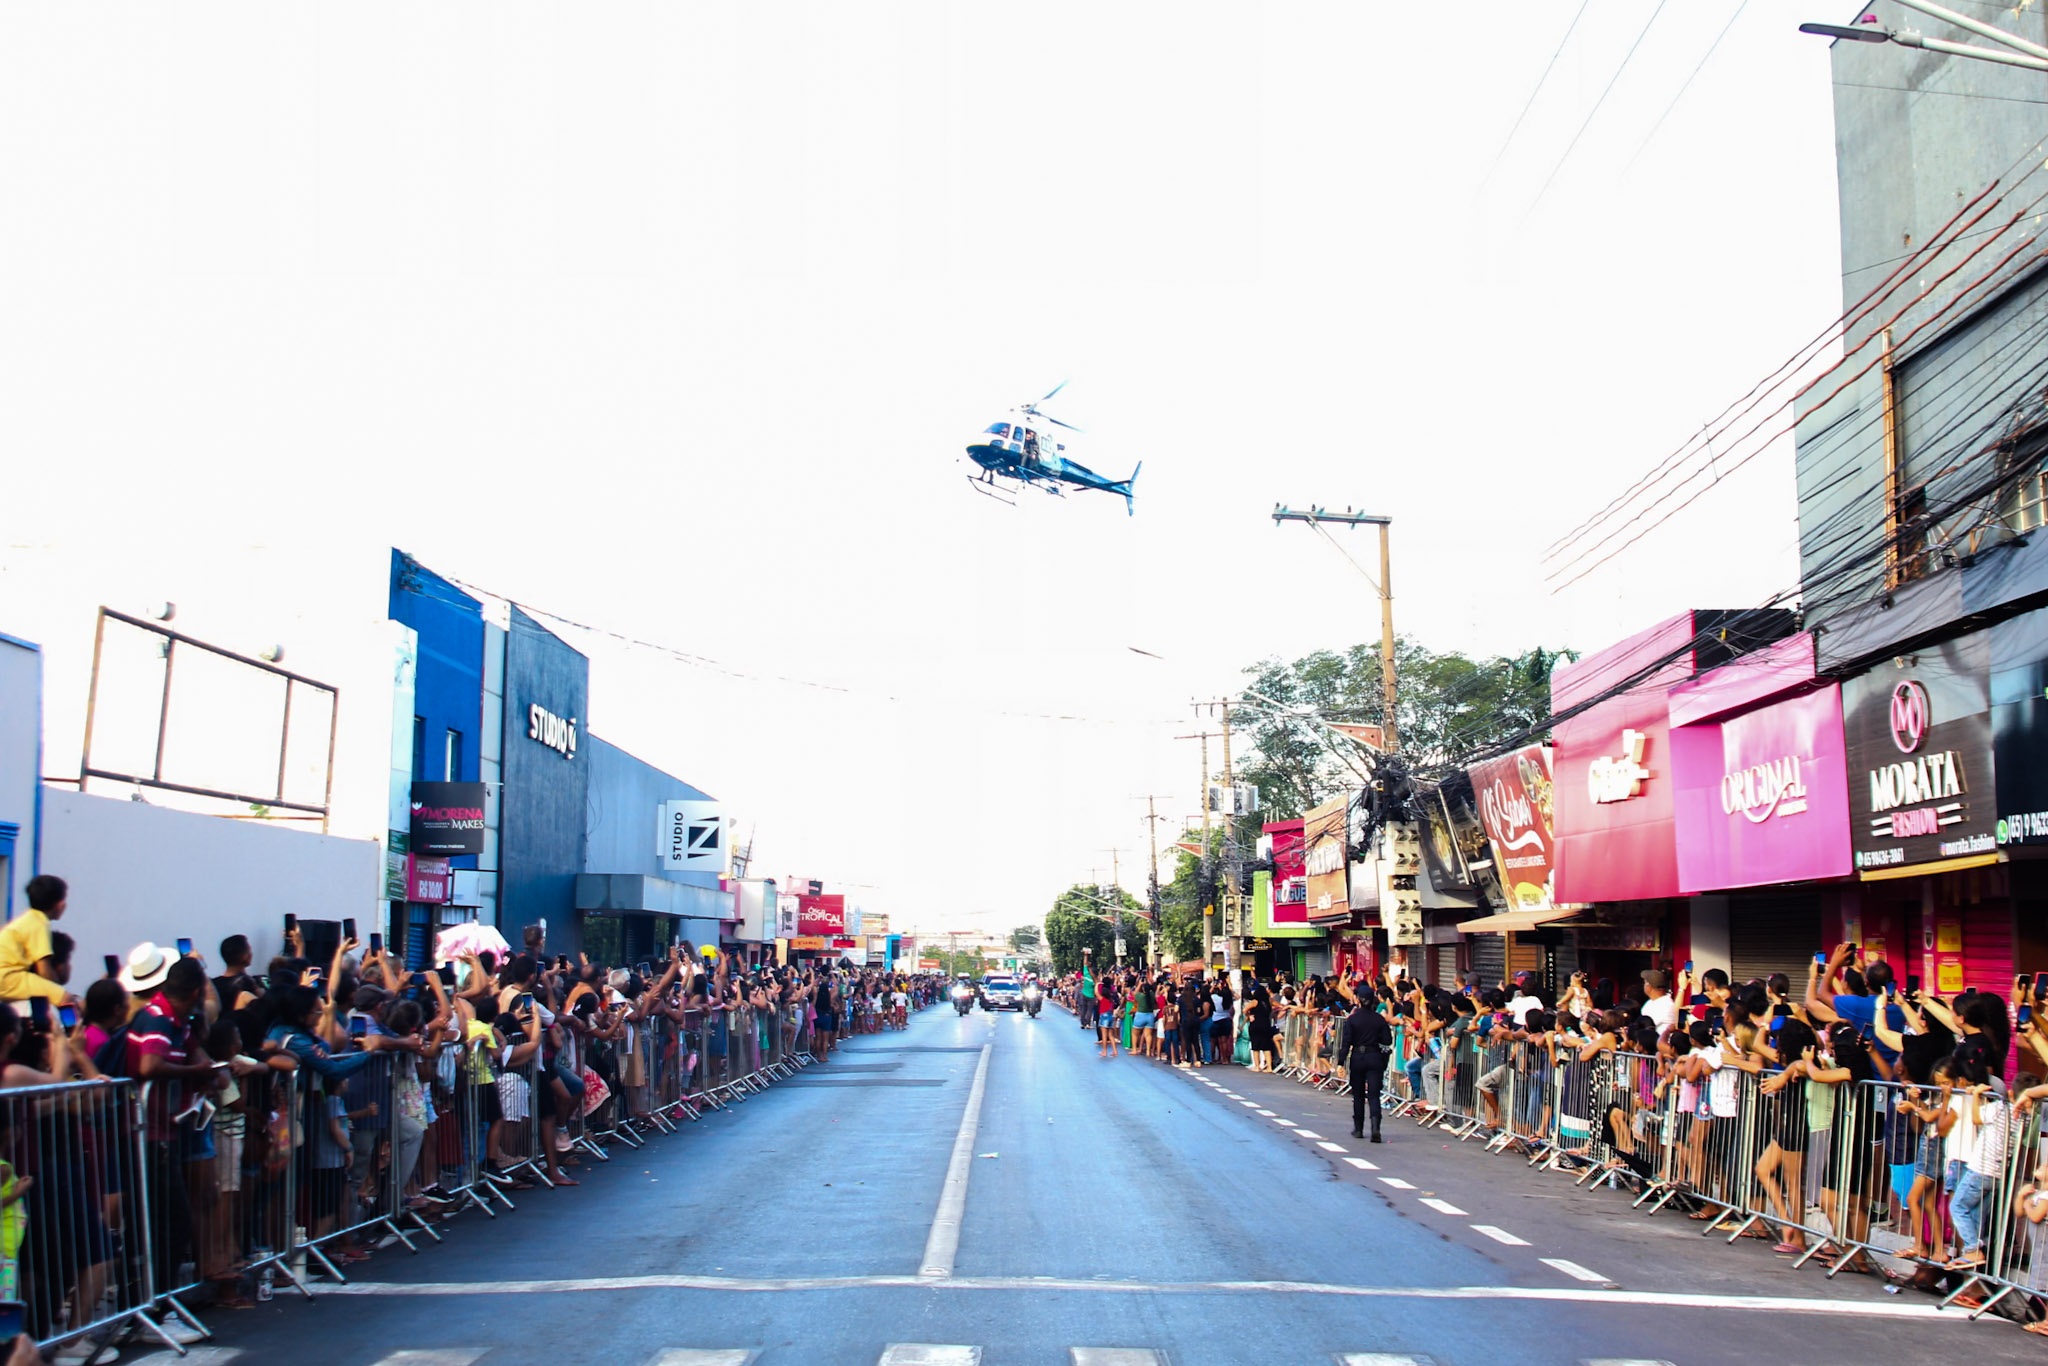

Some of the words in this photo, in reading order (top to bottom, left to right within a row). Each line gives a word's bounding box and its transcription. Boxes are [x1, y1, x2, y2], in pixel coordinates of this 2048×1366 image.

[529, 703, 567, 753] STUDIO
[1870, 751, 1964, 812] MORATA
[424, 807, 484, 820] MORENA
[452, 819, 484, 830] MAKES
[1890, 807, 1938, 838] FASHION
[2008, 814, 2023, 844] (65)
[2023, 813, 2030, 836] 9
[672, 812, 684, 861] STUDIO
[800, 912, 843, 924] TROPICAL
